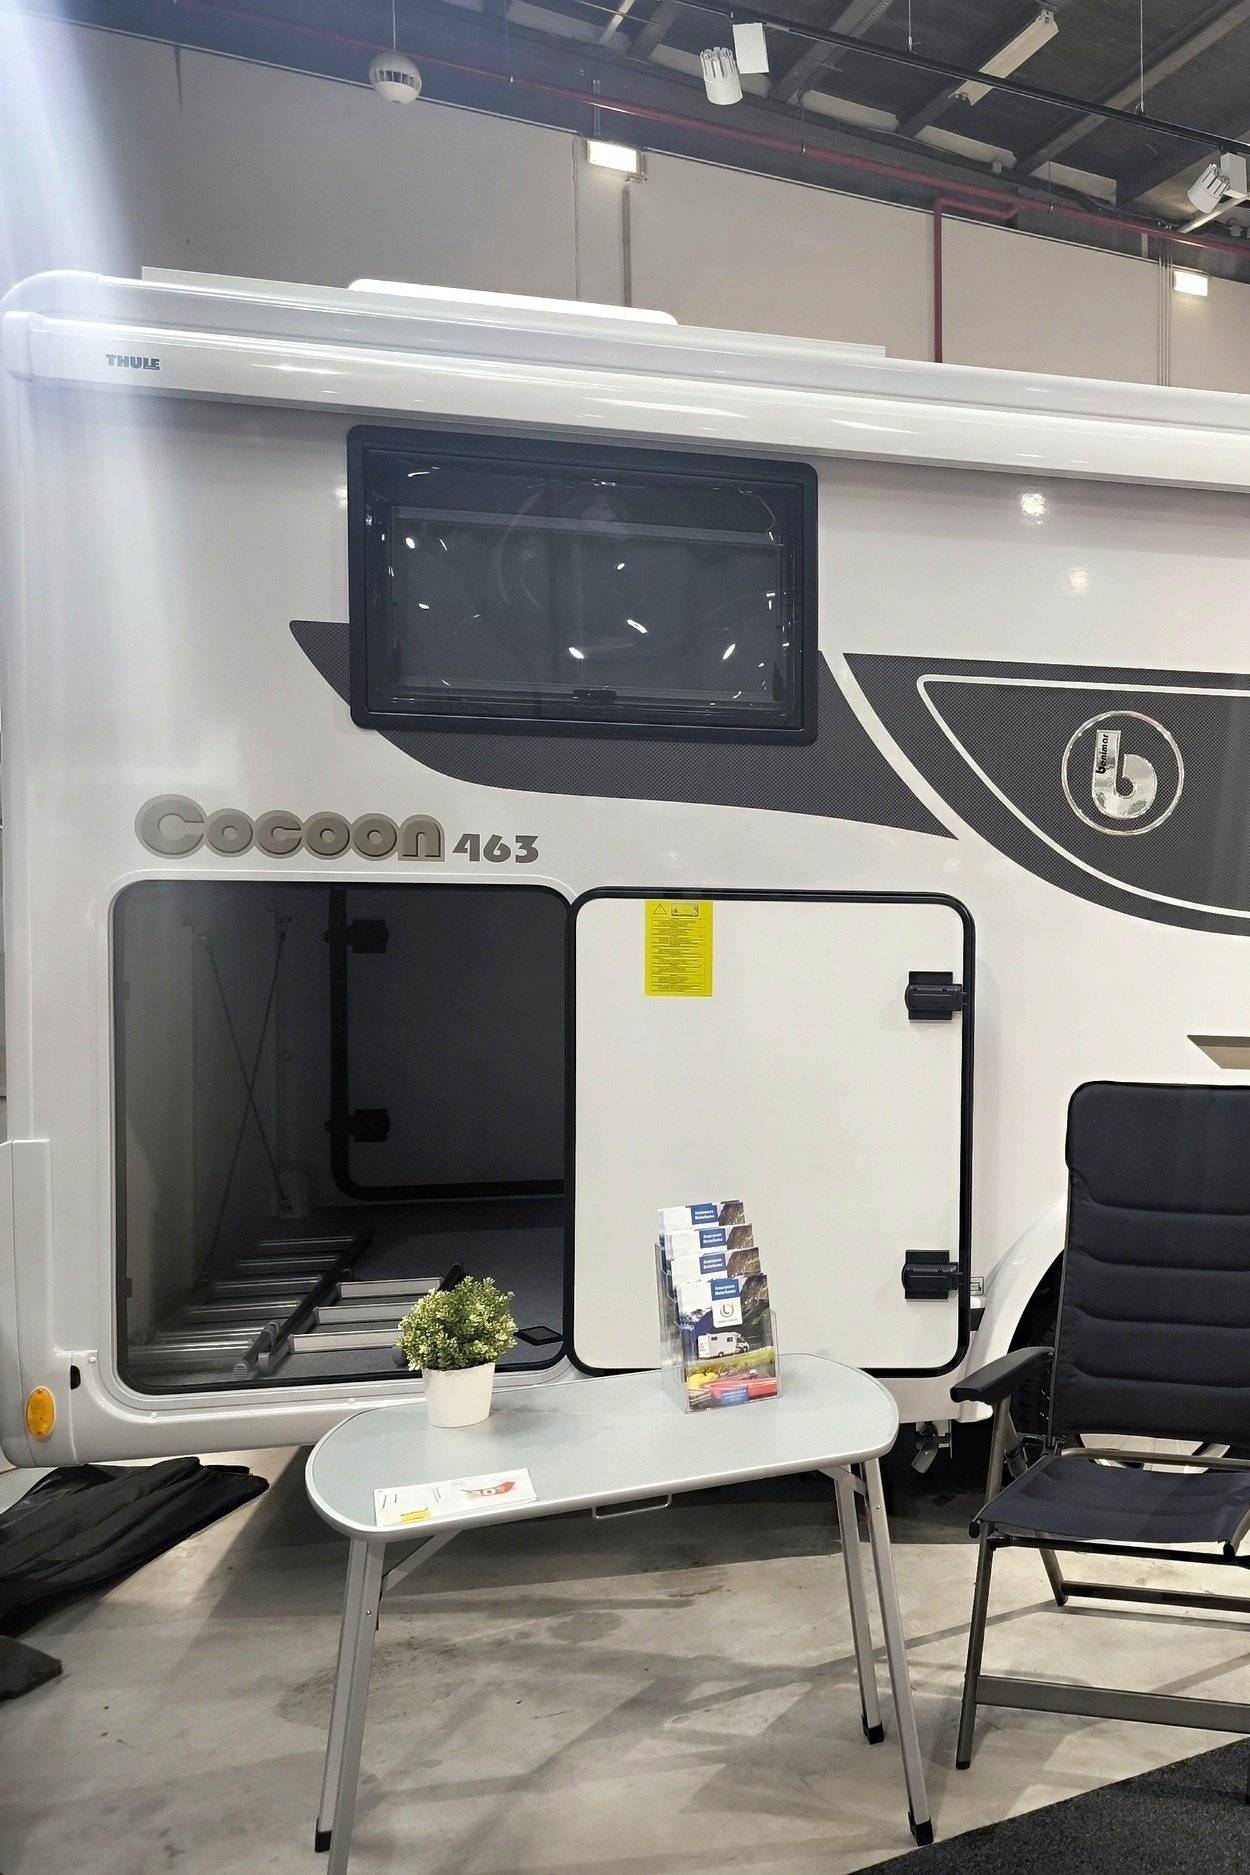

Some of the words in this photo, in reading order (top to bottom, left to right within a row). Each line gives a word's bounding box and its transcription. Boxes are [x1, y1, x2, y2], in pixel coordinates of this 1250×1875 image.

[105, 353, 160, 370] THULE
[1095, 733, 1109, 775] benimar
[135, 794, 446, 863] Cocoon
[452, 833, 540, 864] 463
